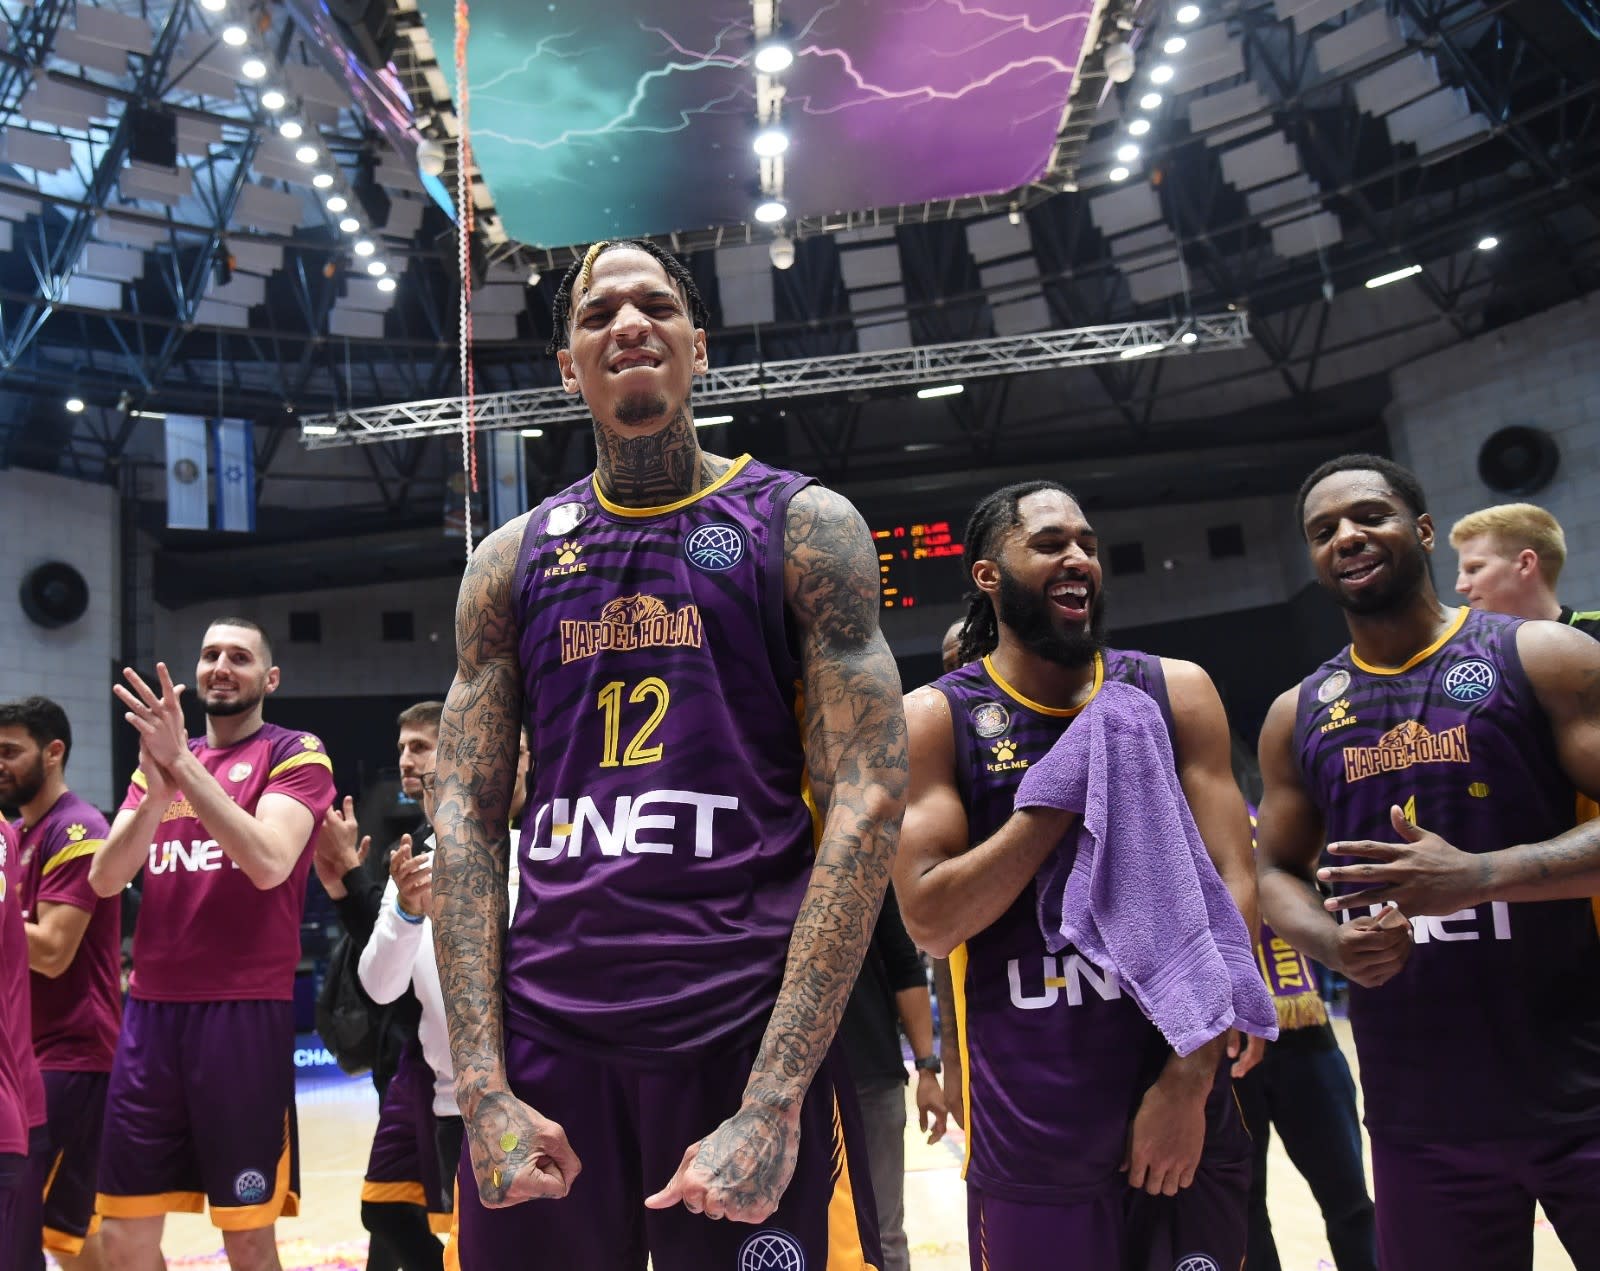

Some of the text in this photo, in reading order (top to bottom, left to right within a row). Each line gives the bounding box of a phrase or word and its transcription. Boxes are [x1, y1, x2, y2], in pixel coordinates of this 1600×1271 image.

[544, 562, 587, 578] KELME
[560, 605, 702, 665] HAPOEL HOLON
[597, 676, 670, 768] 12
[1321, 715, 1358, 734] KELME
[987, 759, 1029, 772] KELME
[529, 790, 739, 861] UNET
[149, 839, 240, 875] UNE
